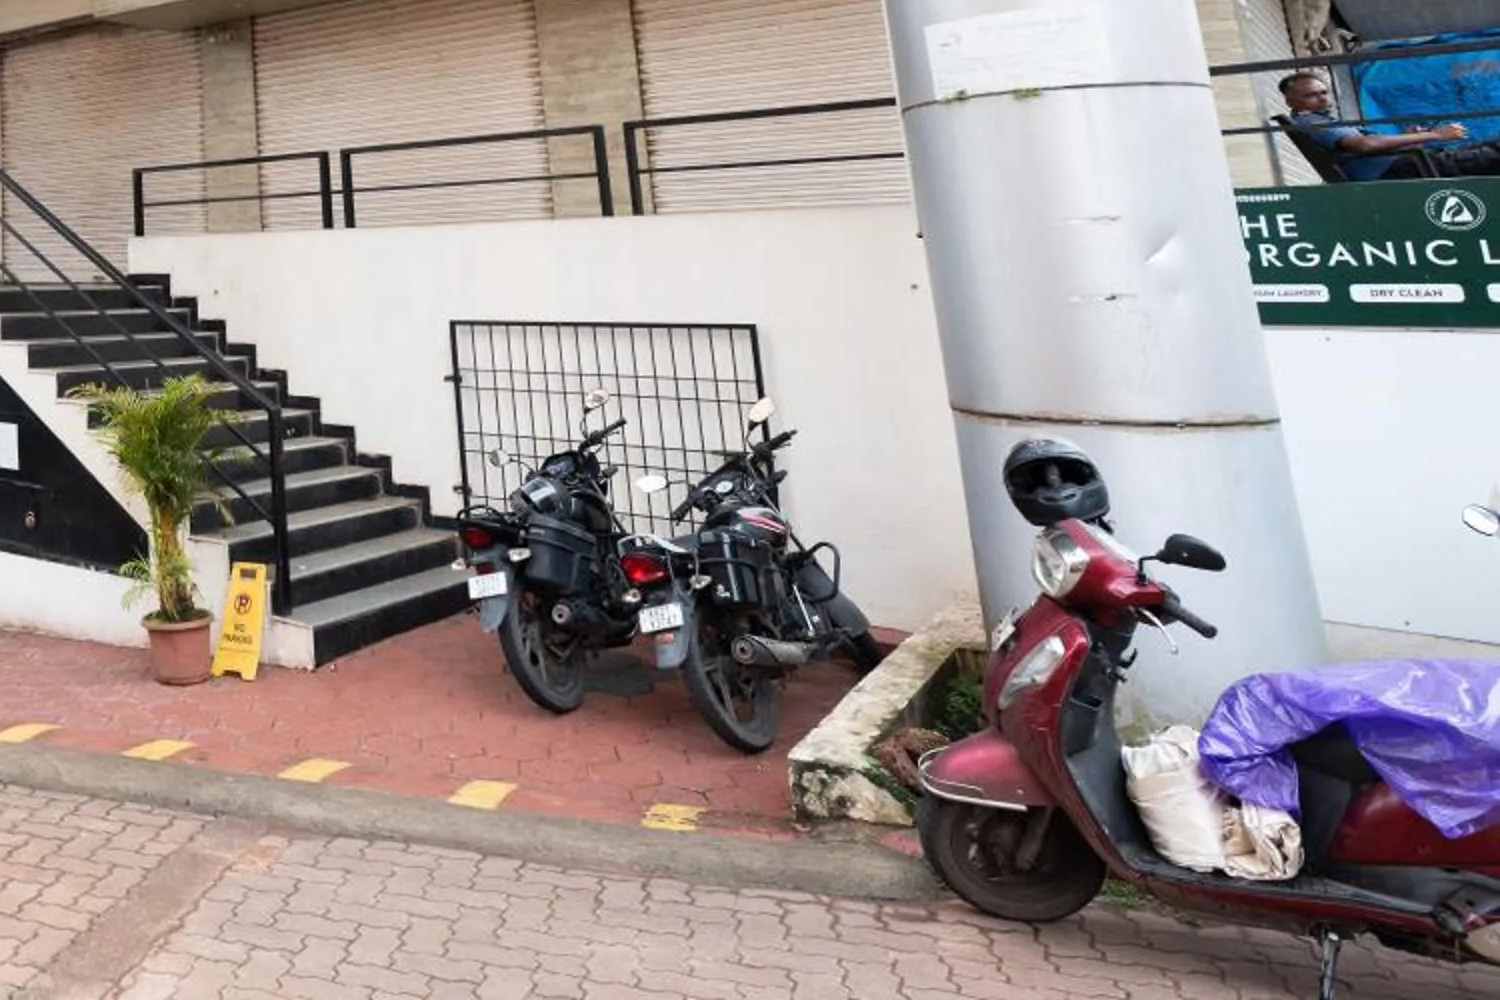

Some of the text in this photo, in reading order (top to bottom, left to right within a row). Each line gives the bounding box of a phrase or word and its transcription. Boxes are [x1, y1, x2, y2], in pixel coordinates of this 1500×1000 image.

[1240, 213, 1299, 239] HE
[1249, 240, 1459, 268] RGANIC
[1370, 288, 1443, 298] DRY CLEAN
